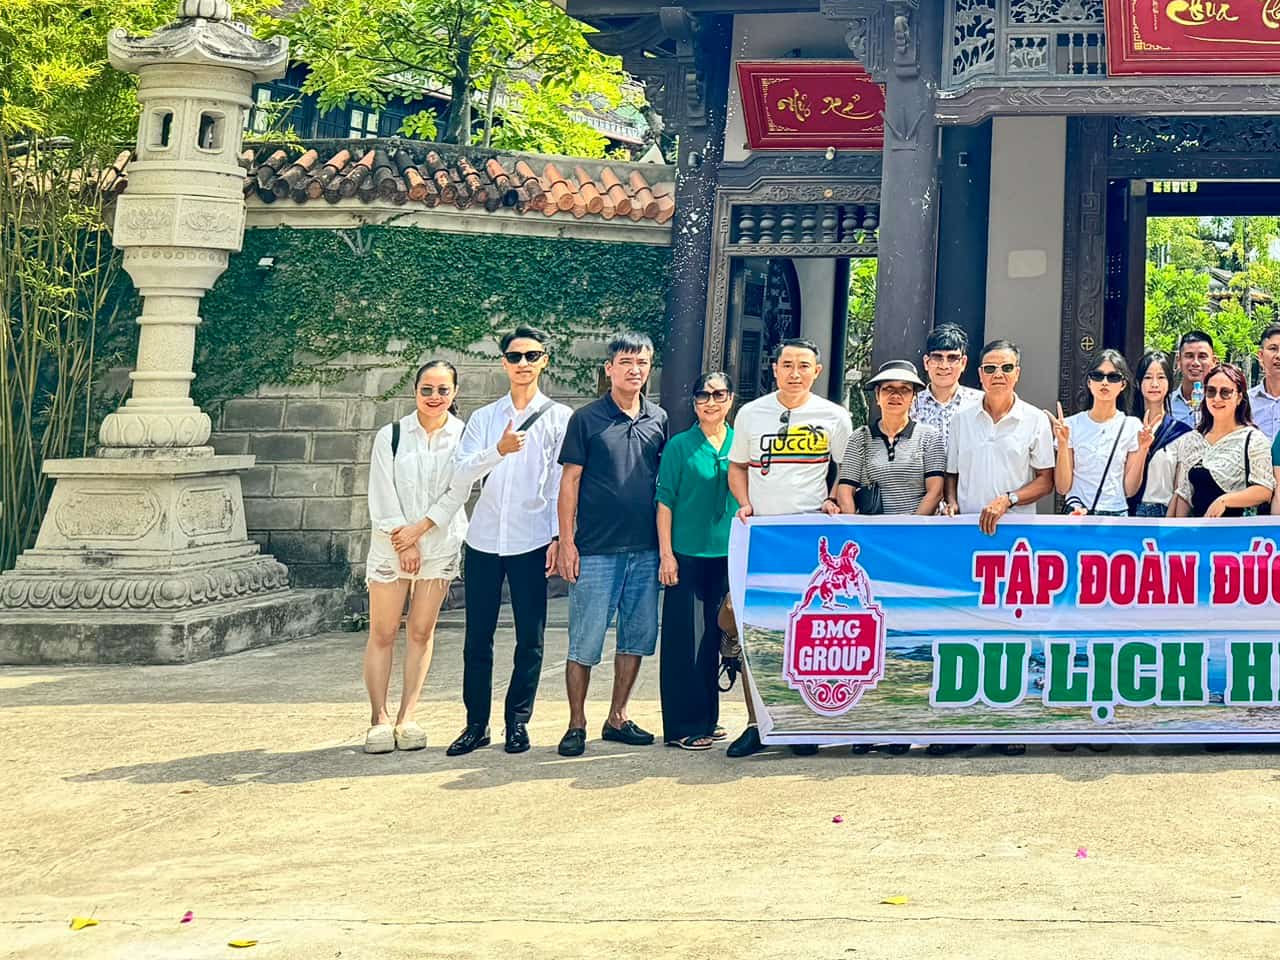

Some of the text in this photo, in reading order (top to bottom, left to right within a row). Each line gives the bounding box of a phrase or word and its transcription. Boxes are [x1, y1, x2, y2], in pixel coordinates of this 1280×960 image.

[974, 539, 1066, 619] TẬP
[1078, 541, 1197, 606] ĐOÀN
[811, 619, 861, 639] BMG
[798, 645, 871, 672] GROUP
[935, 641, 1026, 704] DU
[1048, 641, 1205, 722] LỊCH
